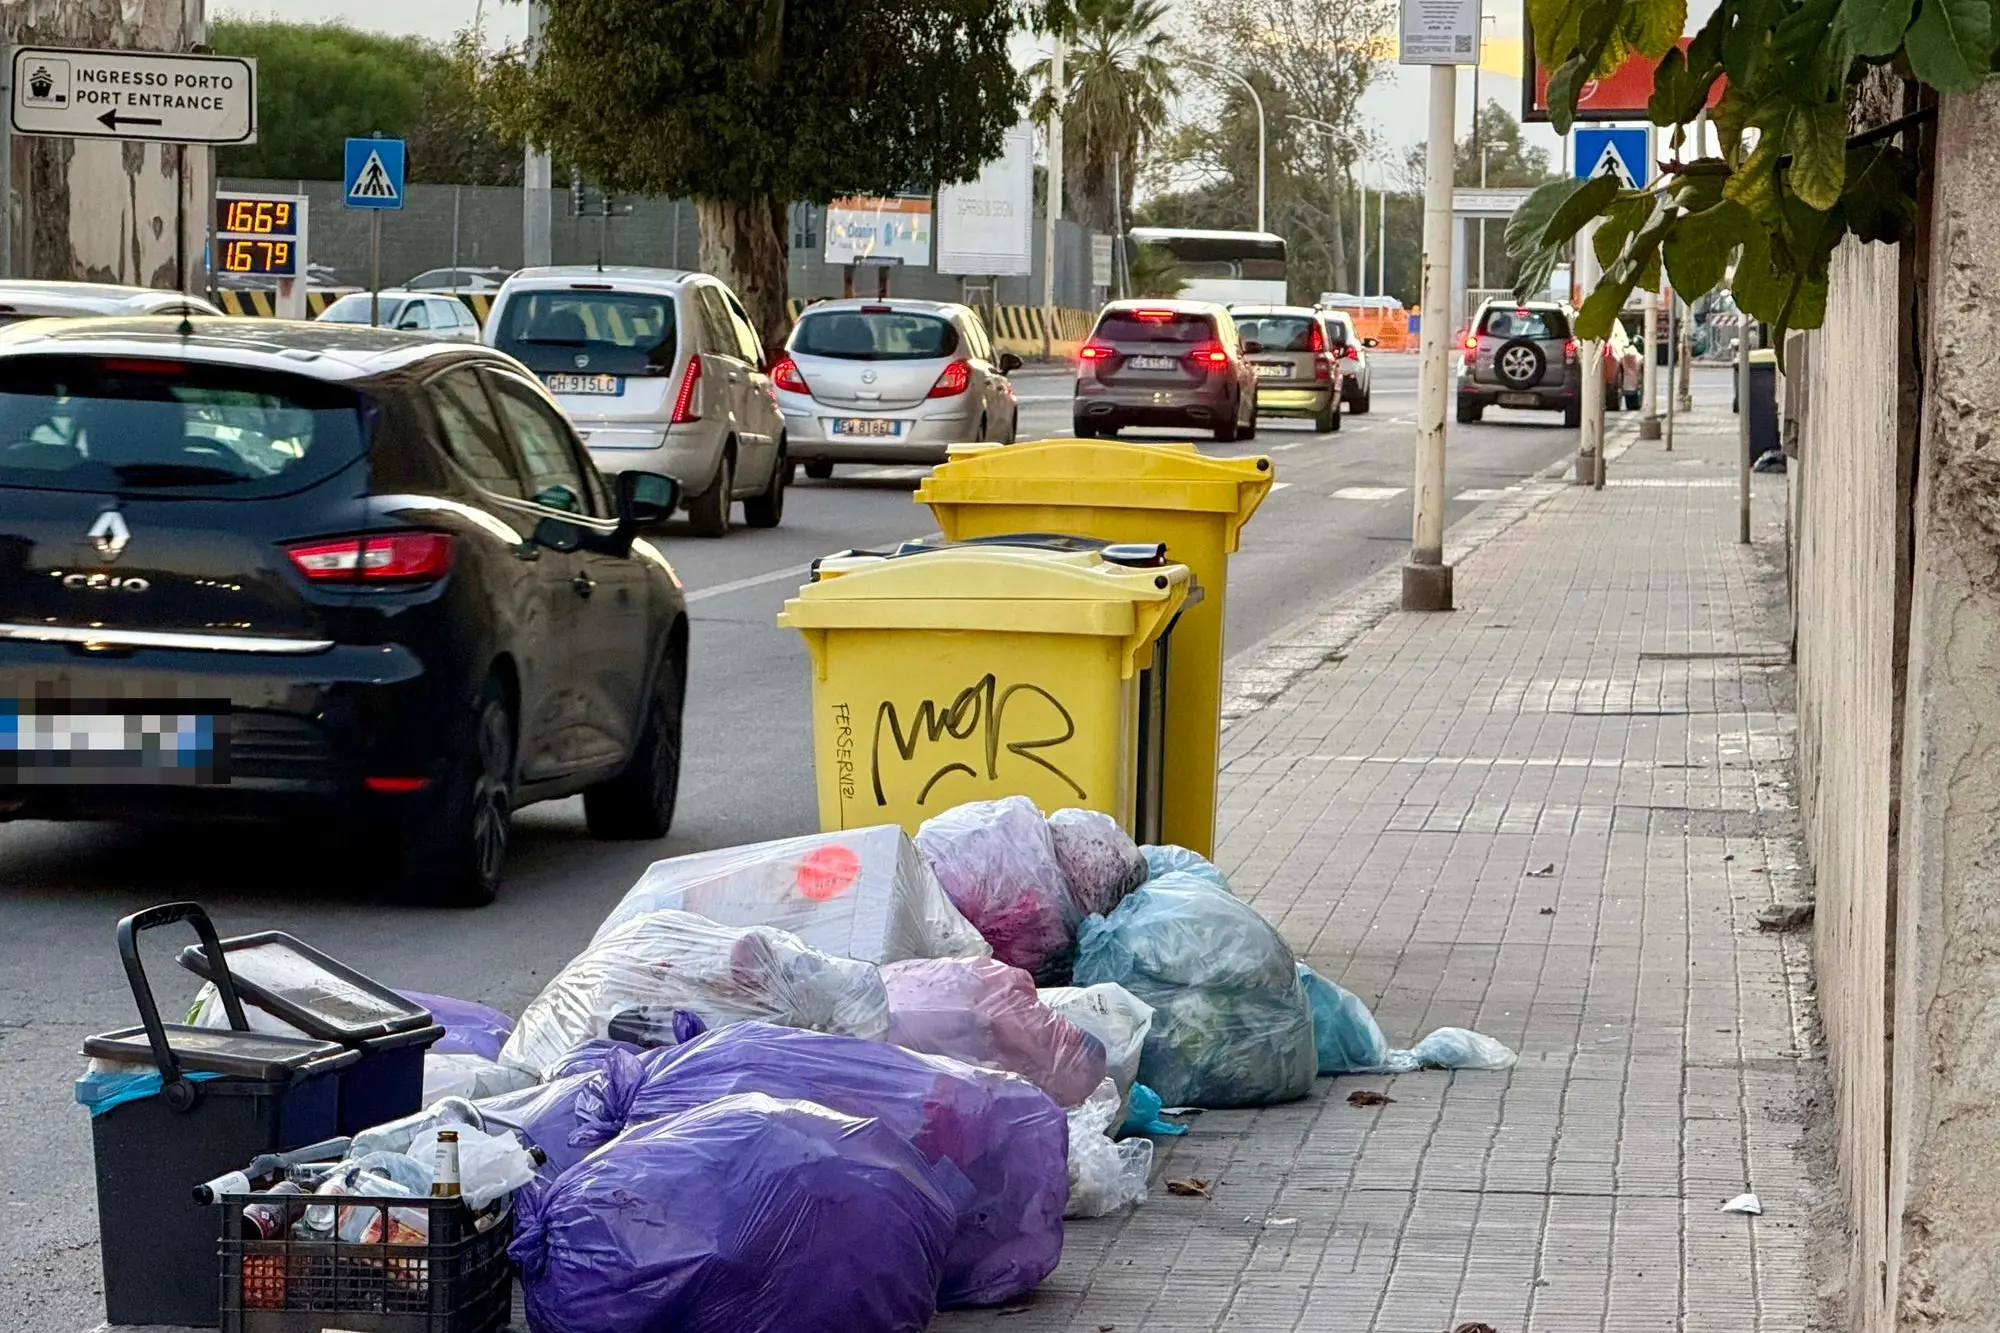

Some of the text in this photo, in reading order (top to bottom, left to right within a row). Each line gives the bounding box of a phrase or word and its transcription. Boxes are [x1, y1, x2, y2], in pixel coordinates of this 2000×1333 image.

[77, 69, 233, 89] INGRESSO PORTO
[76, 90, 224, 110] PORT ENTRANCE
